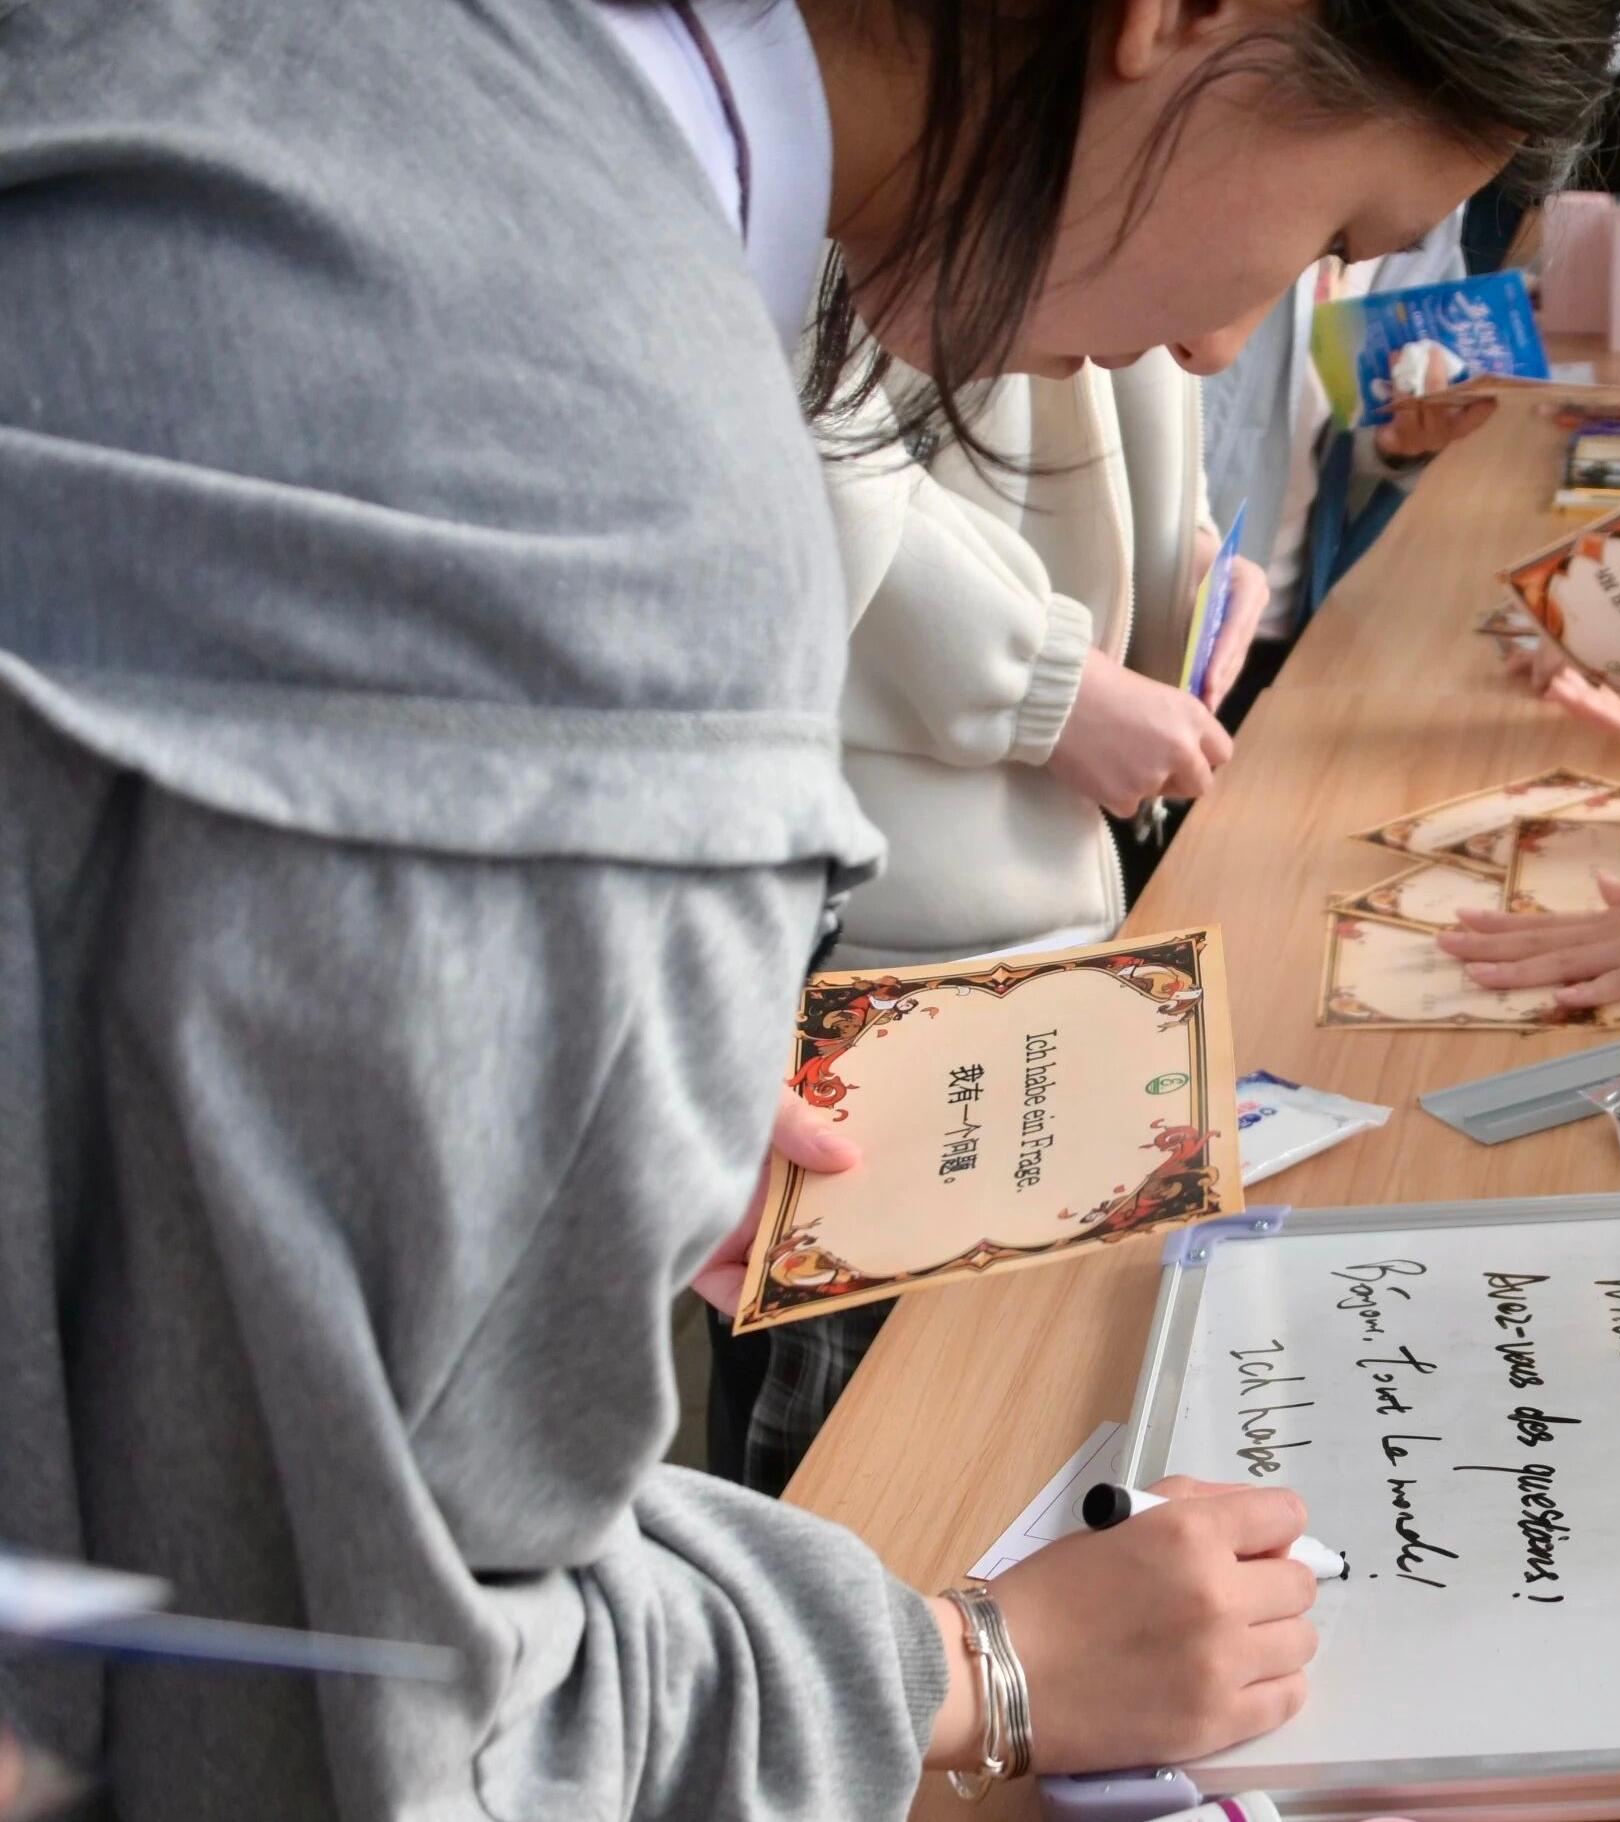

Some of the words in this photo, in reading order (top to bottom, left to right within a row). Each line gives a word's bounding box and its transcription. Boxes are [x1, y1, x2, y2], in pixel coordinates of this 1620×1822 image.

[1025, 1028, 1058, 1062] Ich
[1024, 1062, 1057, 1106] habe
[939, 1063, 985, 1185] 我有一个问题。
[1021, 1108, 1055, 1136] ein
[1014, 1135, 1055, 1193] Frage.
[1484, 1272, 1550, 1388] Avez-vous
[1230, 1339, 1311, 1396] Ich
[1237, 1402, 1315, 1477] habe
[1506, 1406, 1582, 1447] des
